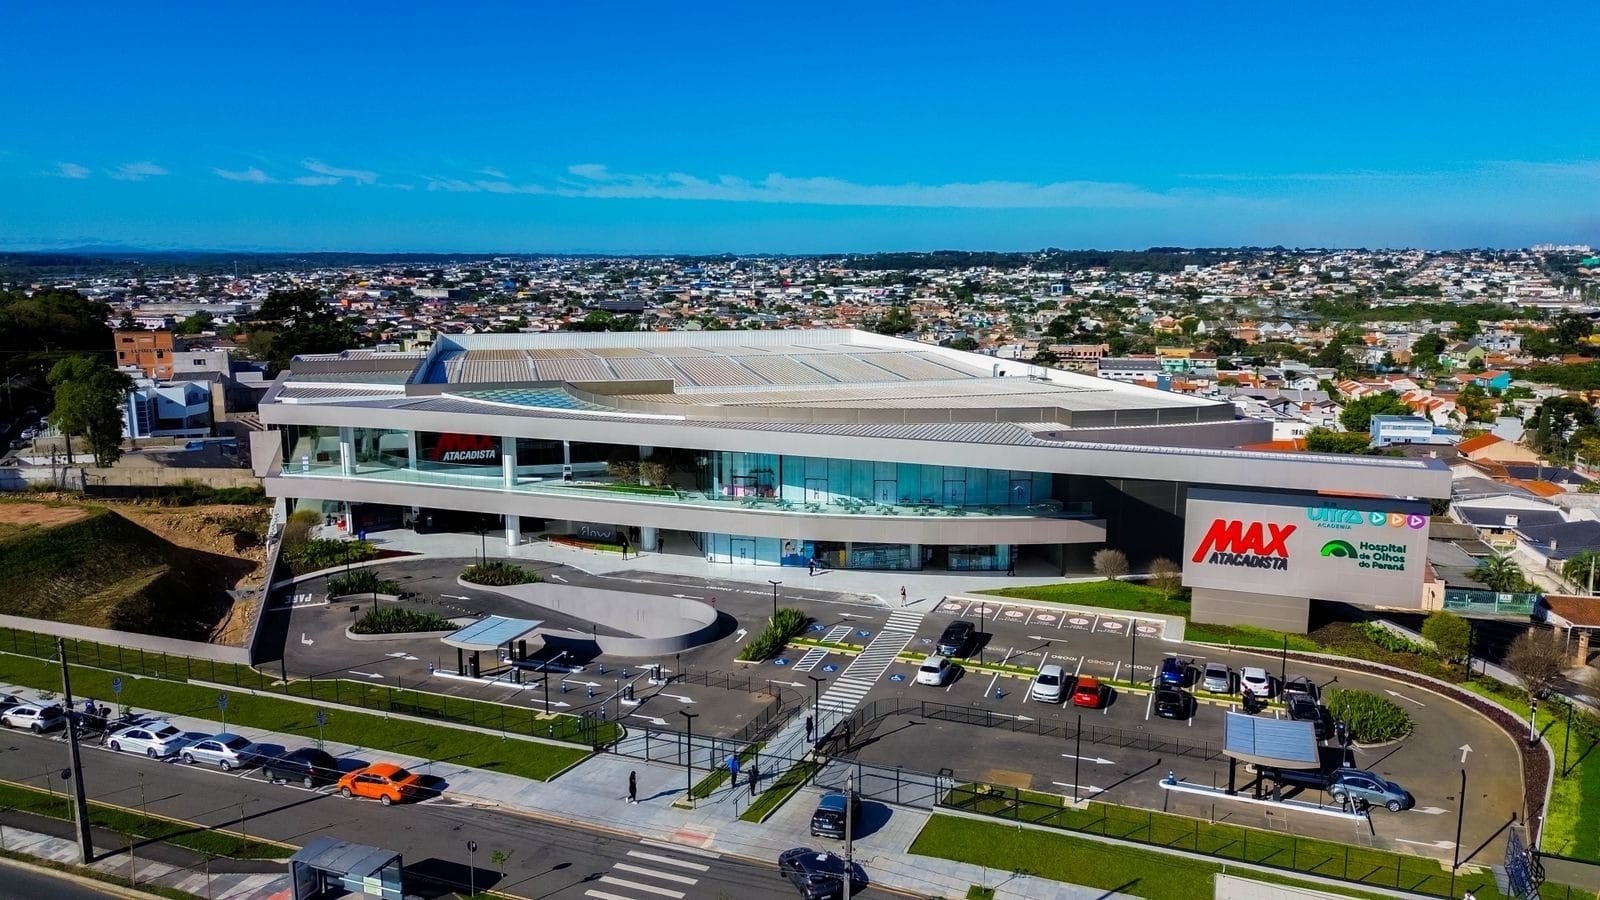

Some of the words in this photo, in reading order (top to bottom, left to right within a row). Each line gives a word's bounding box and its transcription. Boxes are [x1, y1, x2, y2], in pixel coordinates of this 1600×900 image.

[443, 449, 496, 461] ATACADISTA
[1318, 522, 1352, 530] ACADEMIA
[1192, 518, 1297, 563] MAX
[1360, 541, 1407, 554] Hospital
[1208, 551, 1288, 571] ATACADISTA
[1373, 552, 1406, 563] Olhos
[1372, 561, 1405, 571] Paraná
